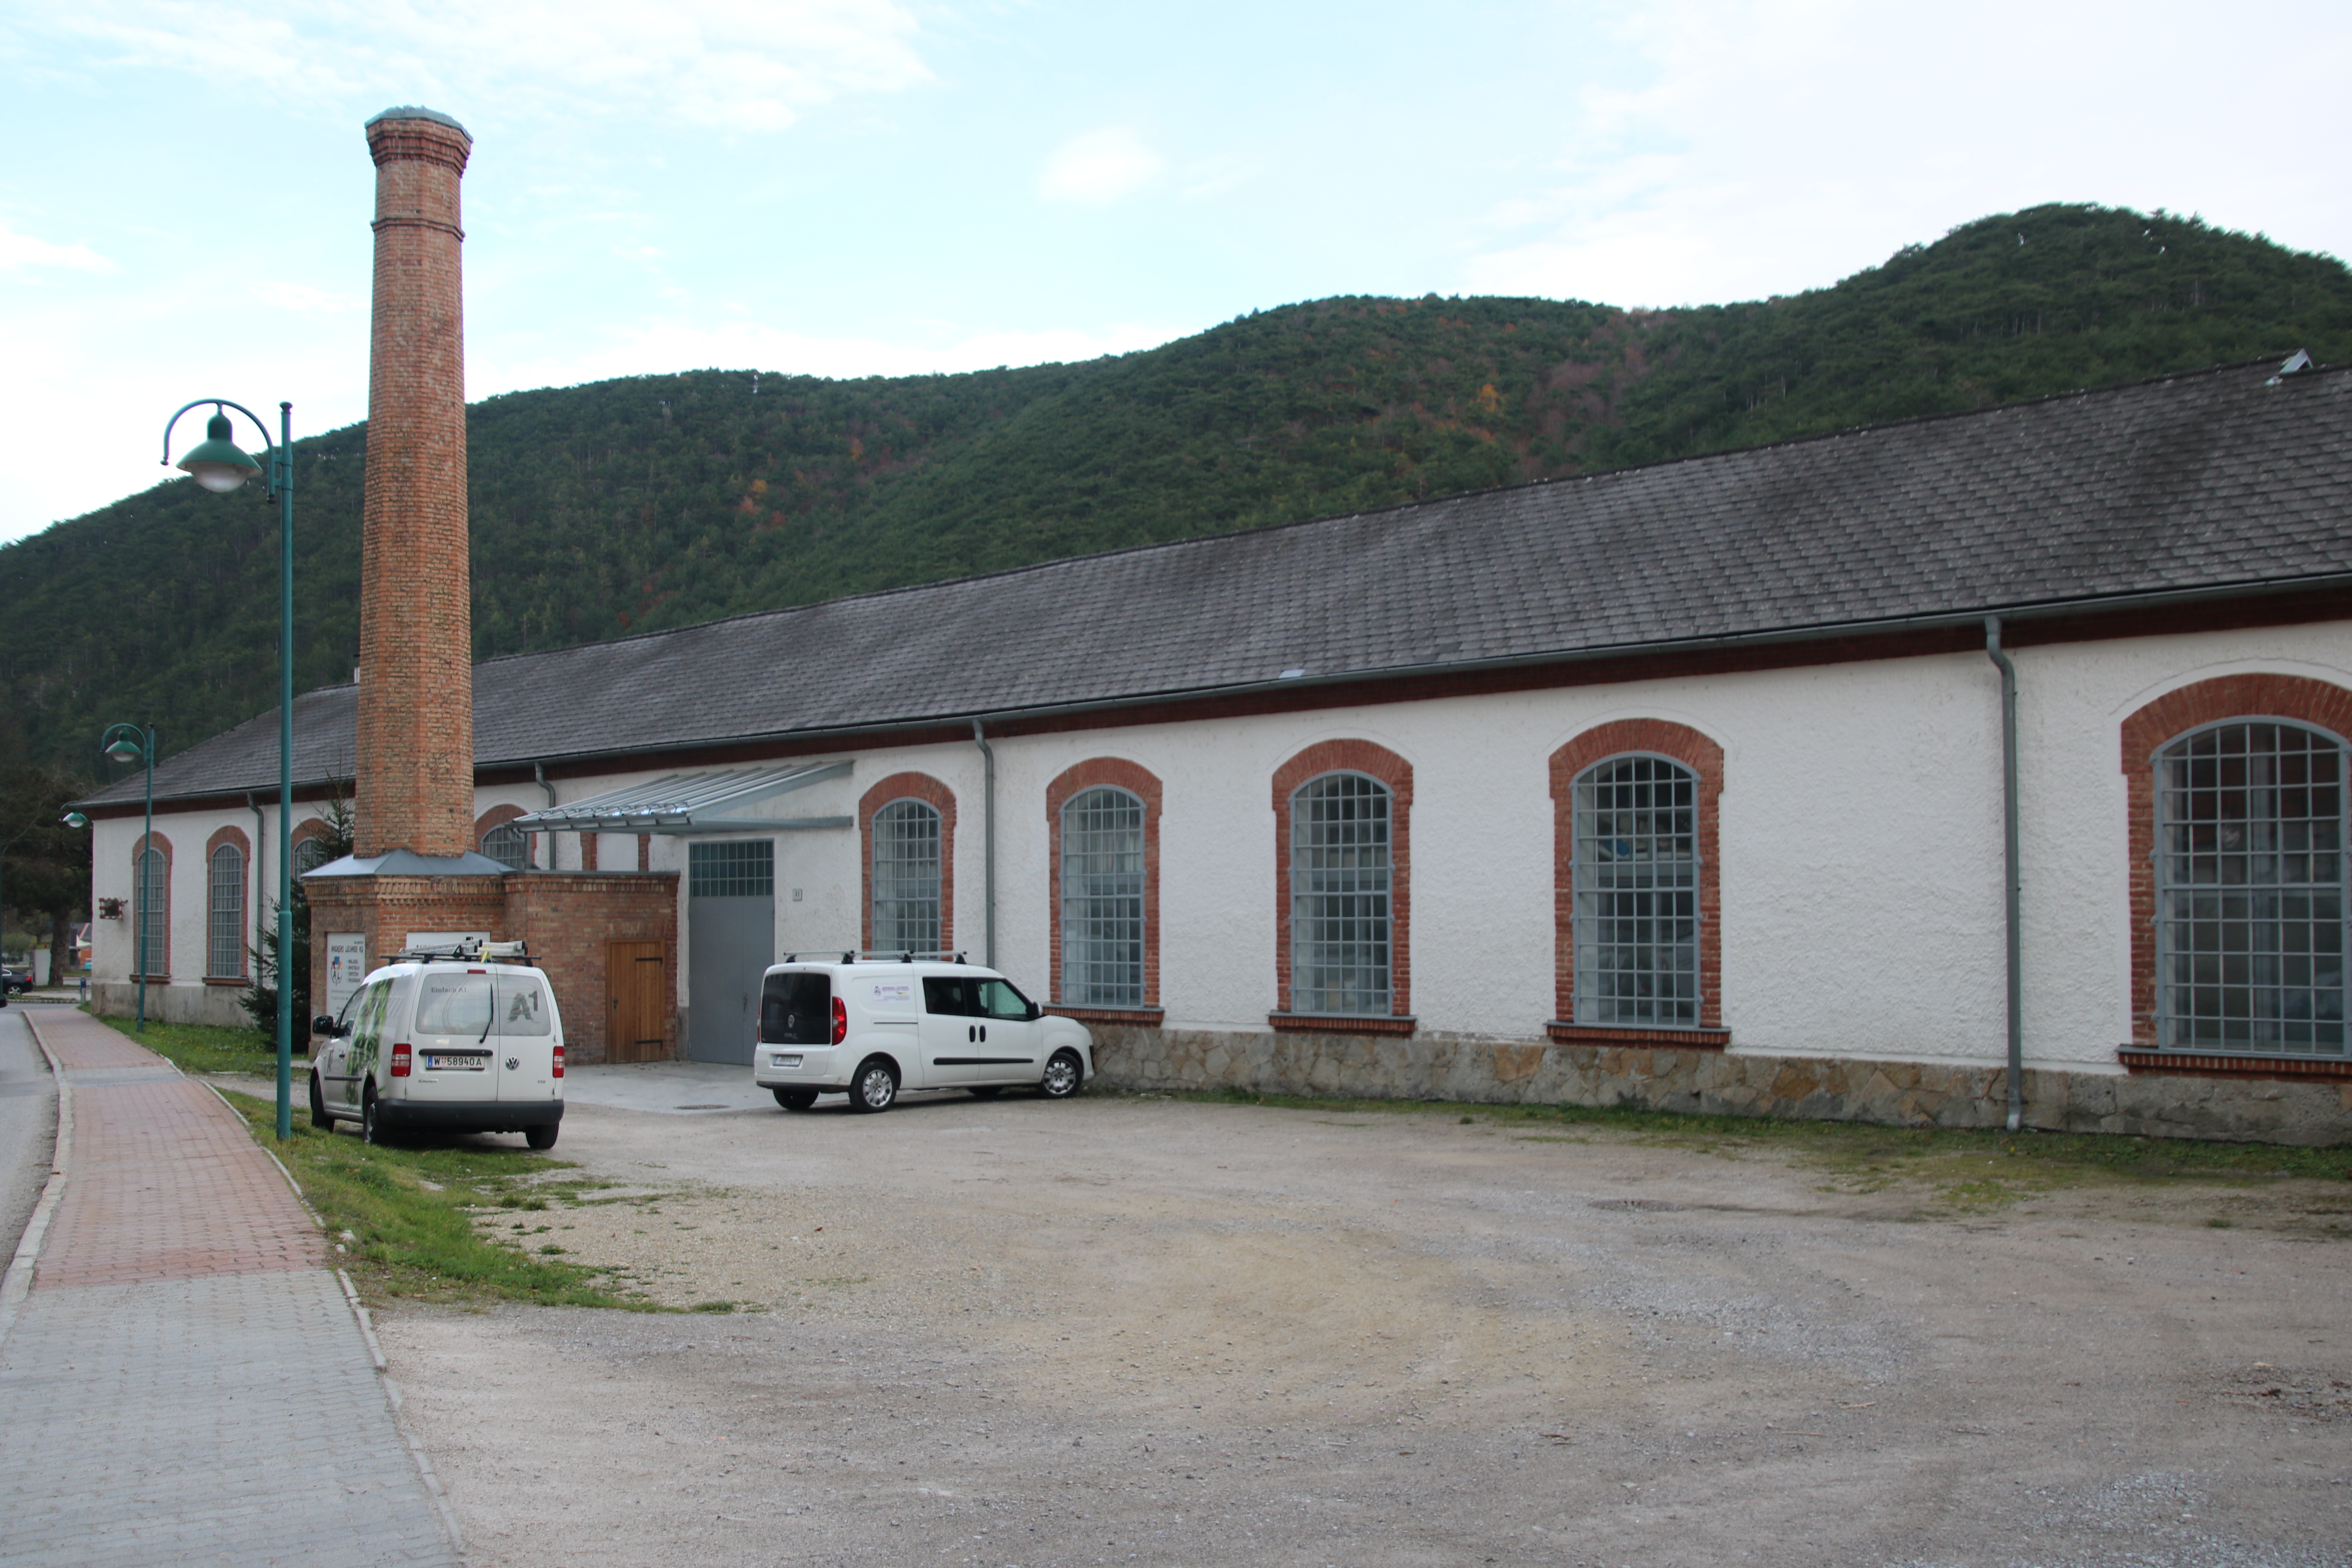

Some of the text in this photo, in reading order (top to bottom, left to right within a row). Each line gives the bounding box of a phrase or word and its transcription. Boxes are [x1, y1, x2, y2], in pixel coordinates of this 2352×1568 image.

[507, 990, 538, 1022] A1
[447, 1057, 474, 1065] 58940
[476, 1058, 482, 1066] A
